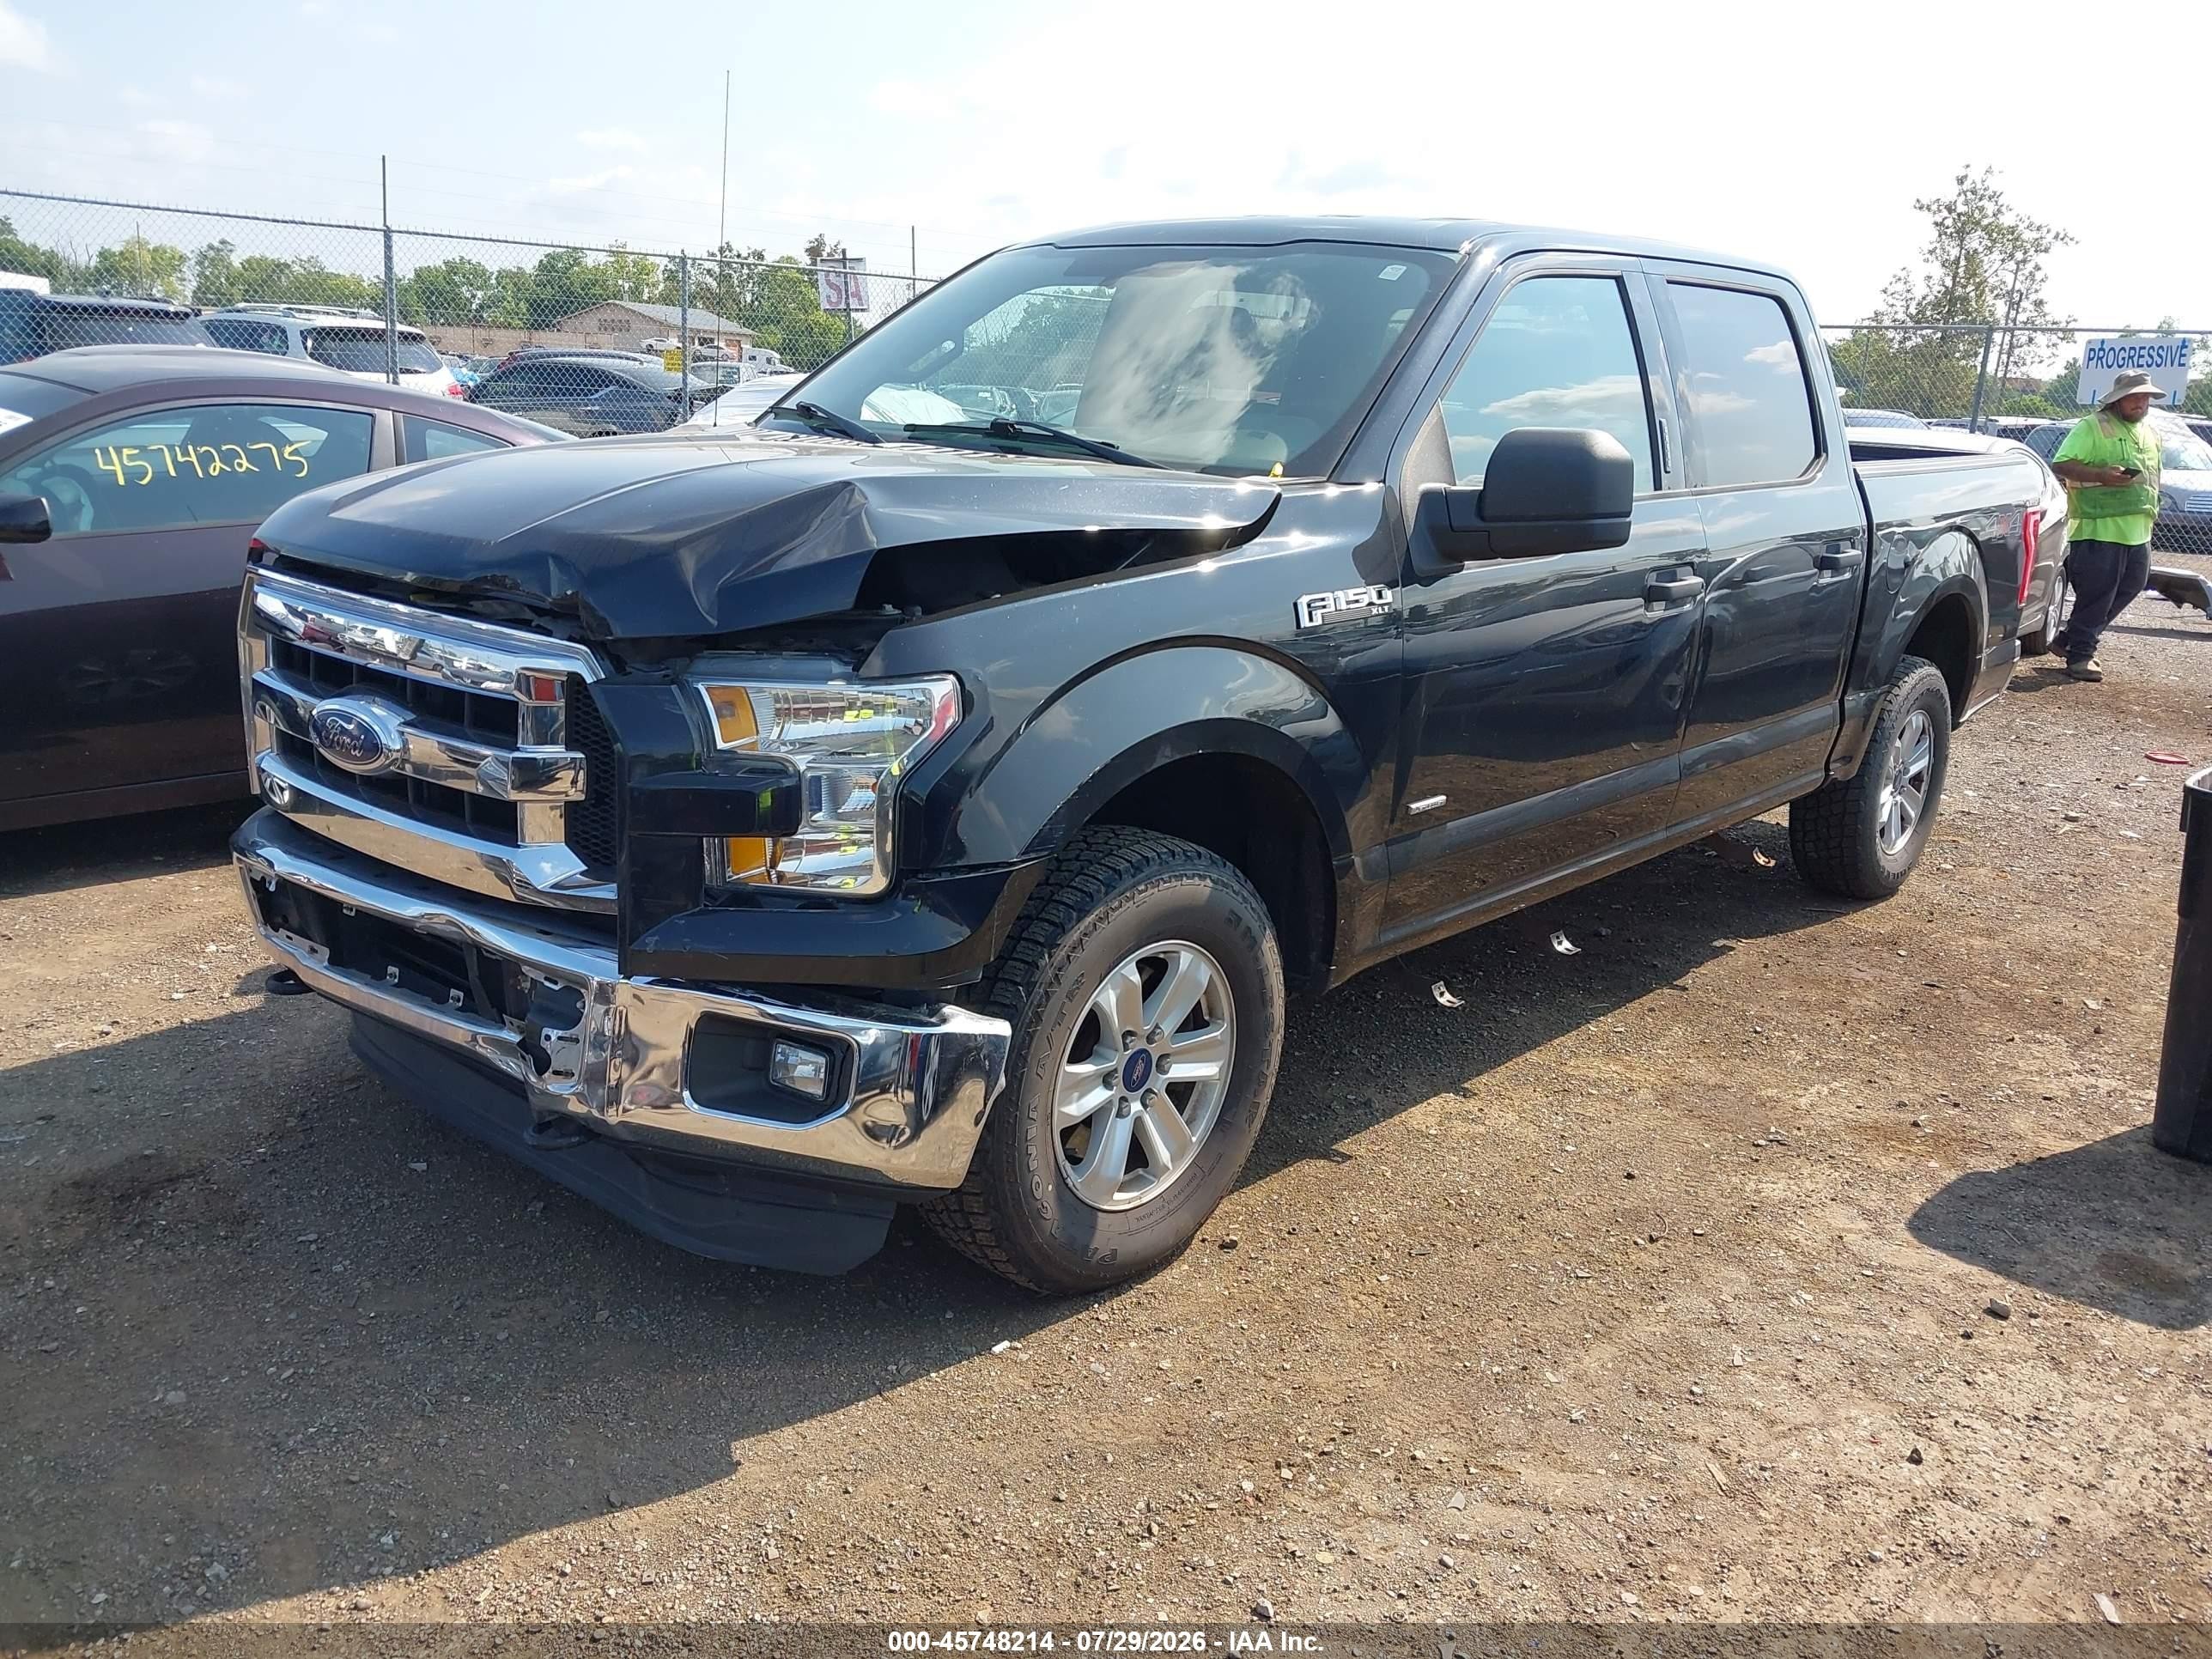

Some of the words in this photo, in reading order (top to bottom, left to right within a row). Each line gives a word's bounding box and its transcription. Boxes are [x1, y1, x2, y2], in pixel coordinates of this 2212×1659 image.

[2086, 344, 2189, 370] PROGRESSIVE
[94, 440, 312, 487] 45742275
[1370, 605, 1389, 616] XLT
[325, 716, 365, 758] Ford
